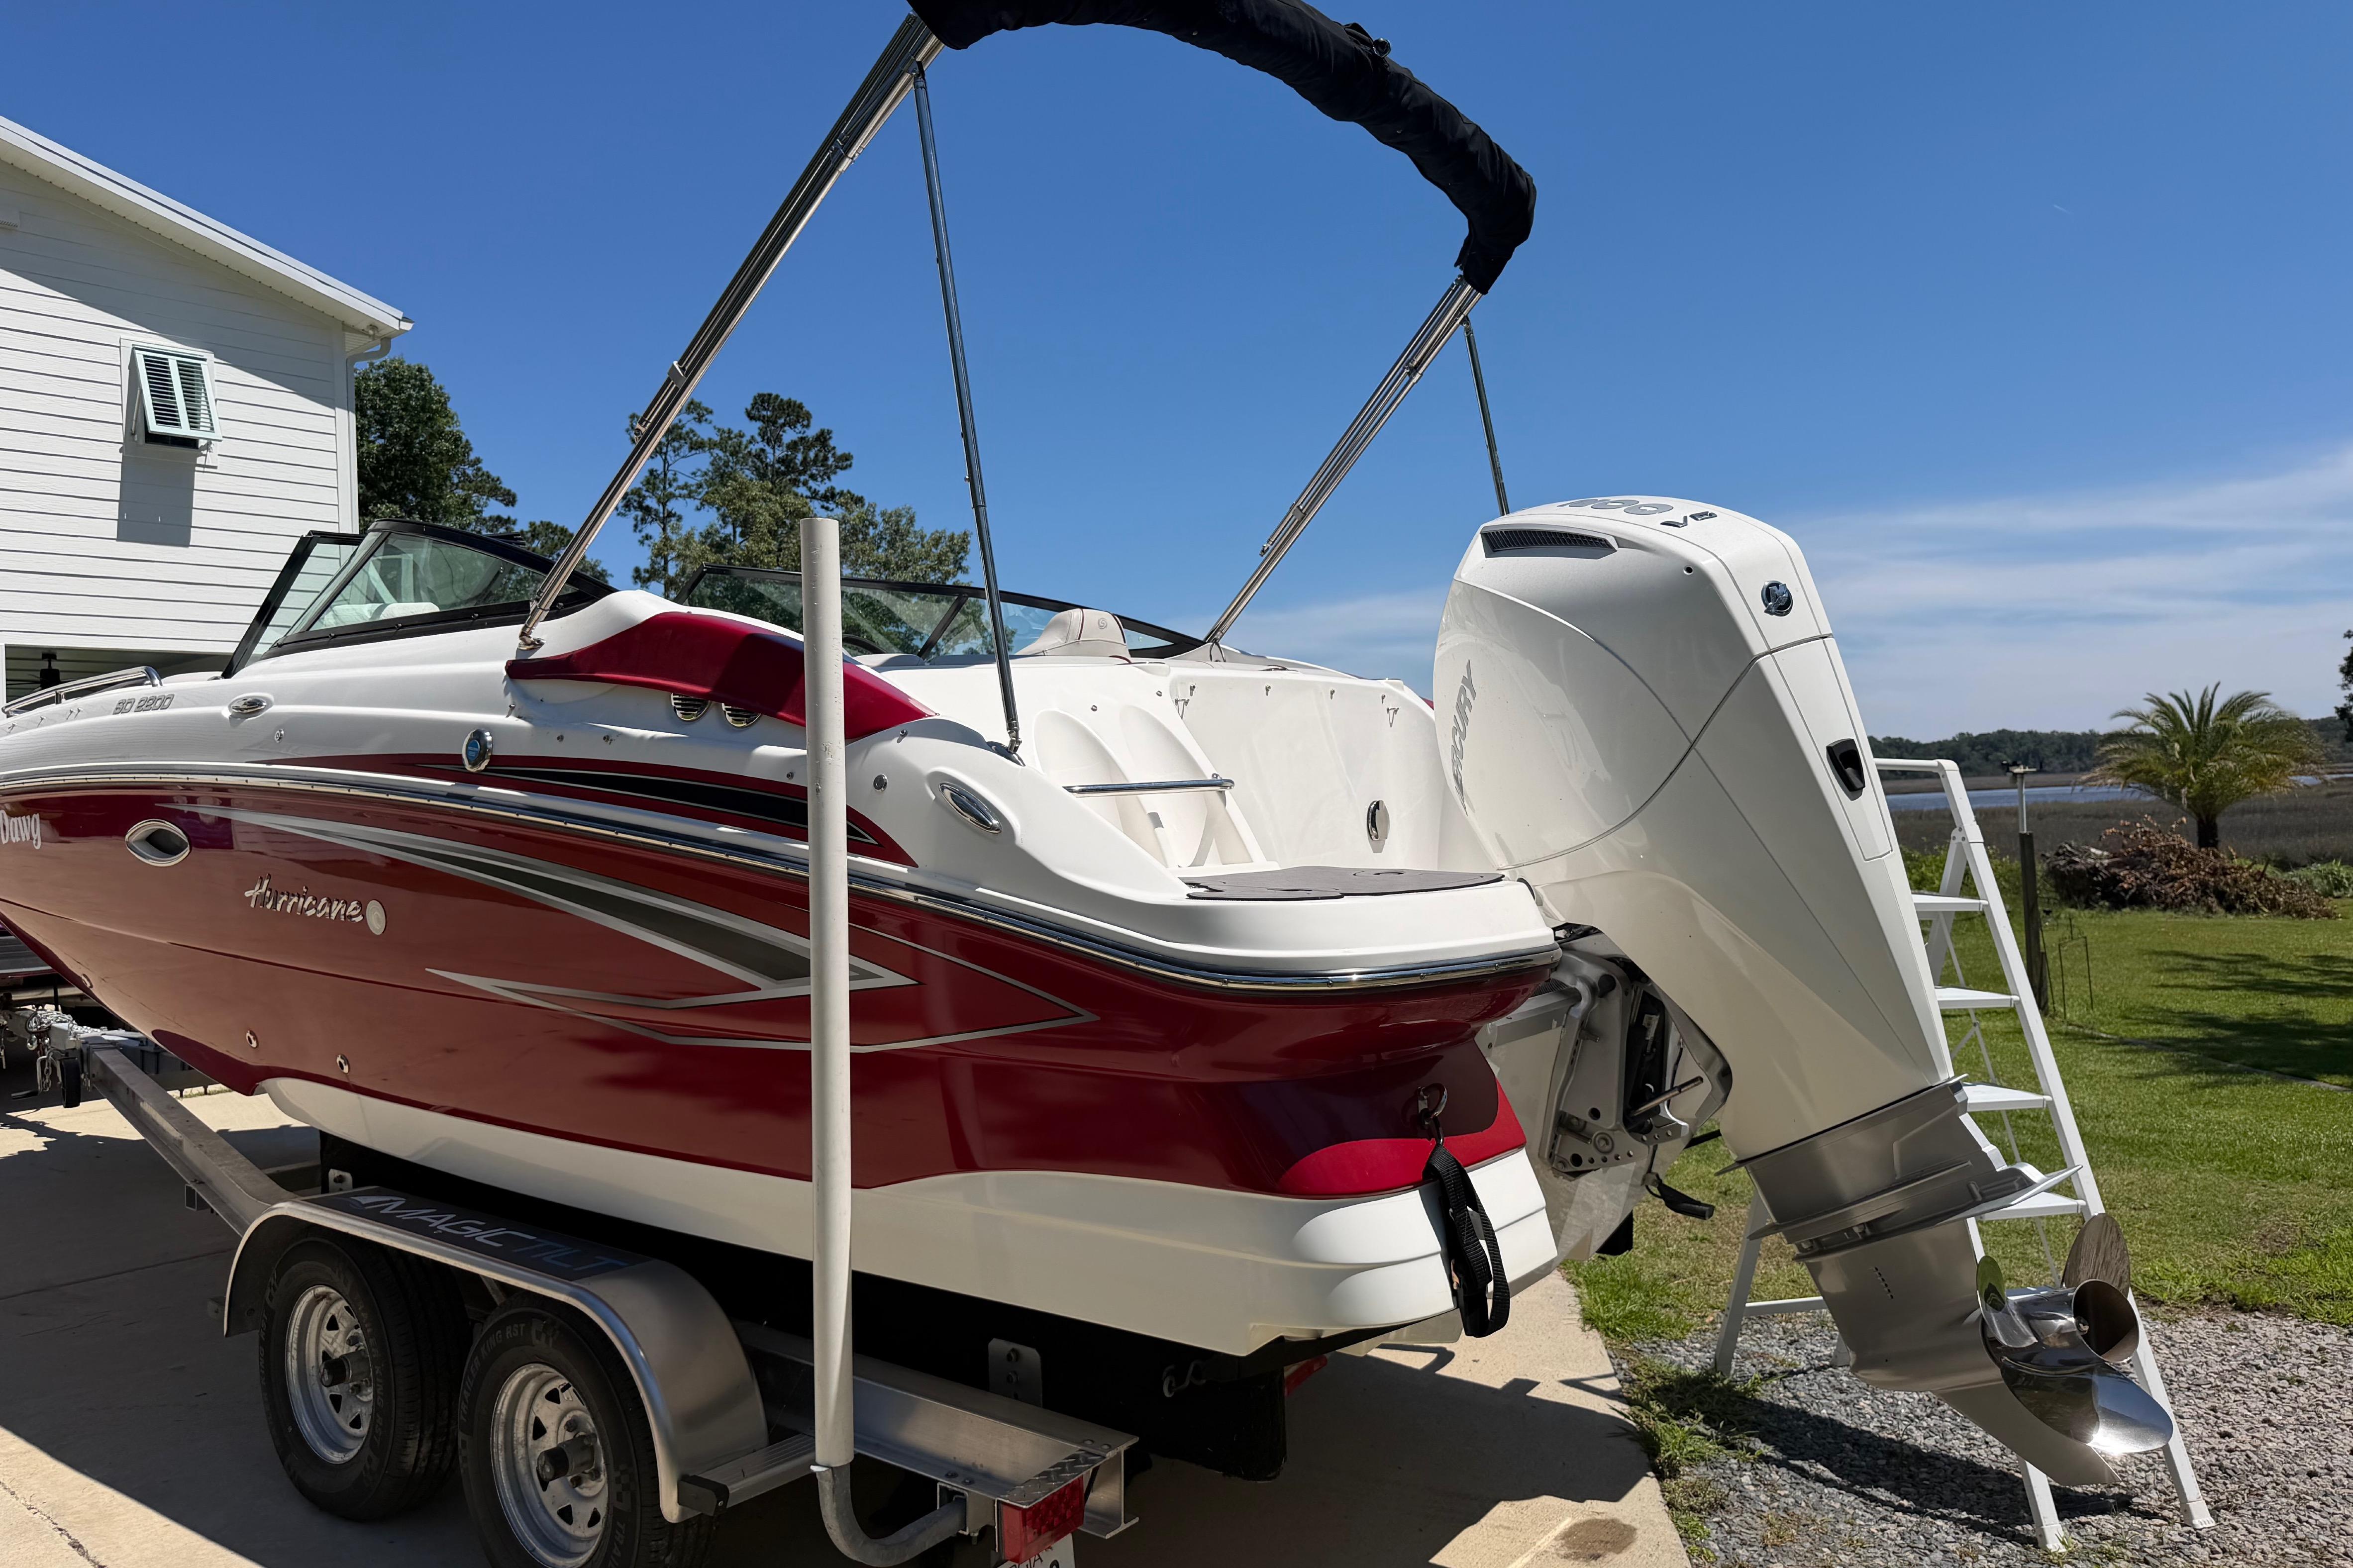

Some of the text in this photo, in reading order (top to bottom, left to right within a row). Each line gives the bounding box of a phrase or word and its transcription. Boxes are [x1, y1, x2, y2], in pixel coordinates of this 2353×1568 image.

[134, 693, 175, 713] 2200
[0, 809, 41, 850] Dawg
[244, 873, 364, 923] Hurricane
[480, 1329, 503, 1360] KING
[506, 1323, 526, 1340] RST
